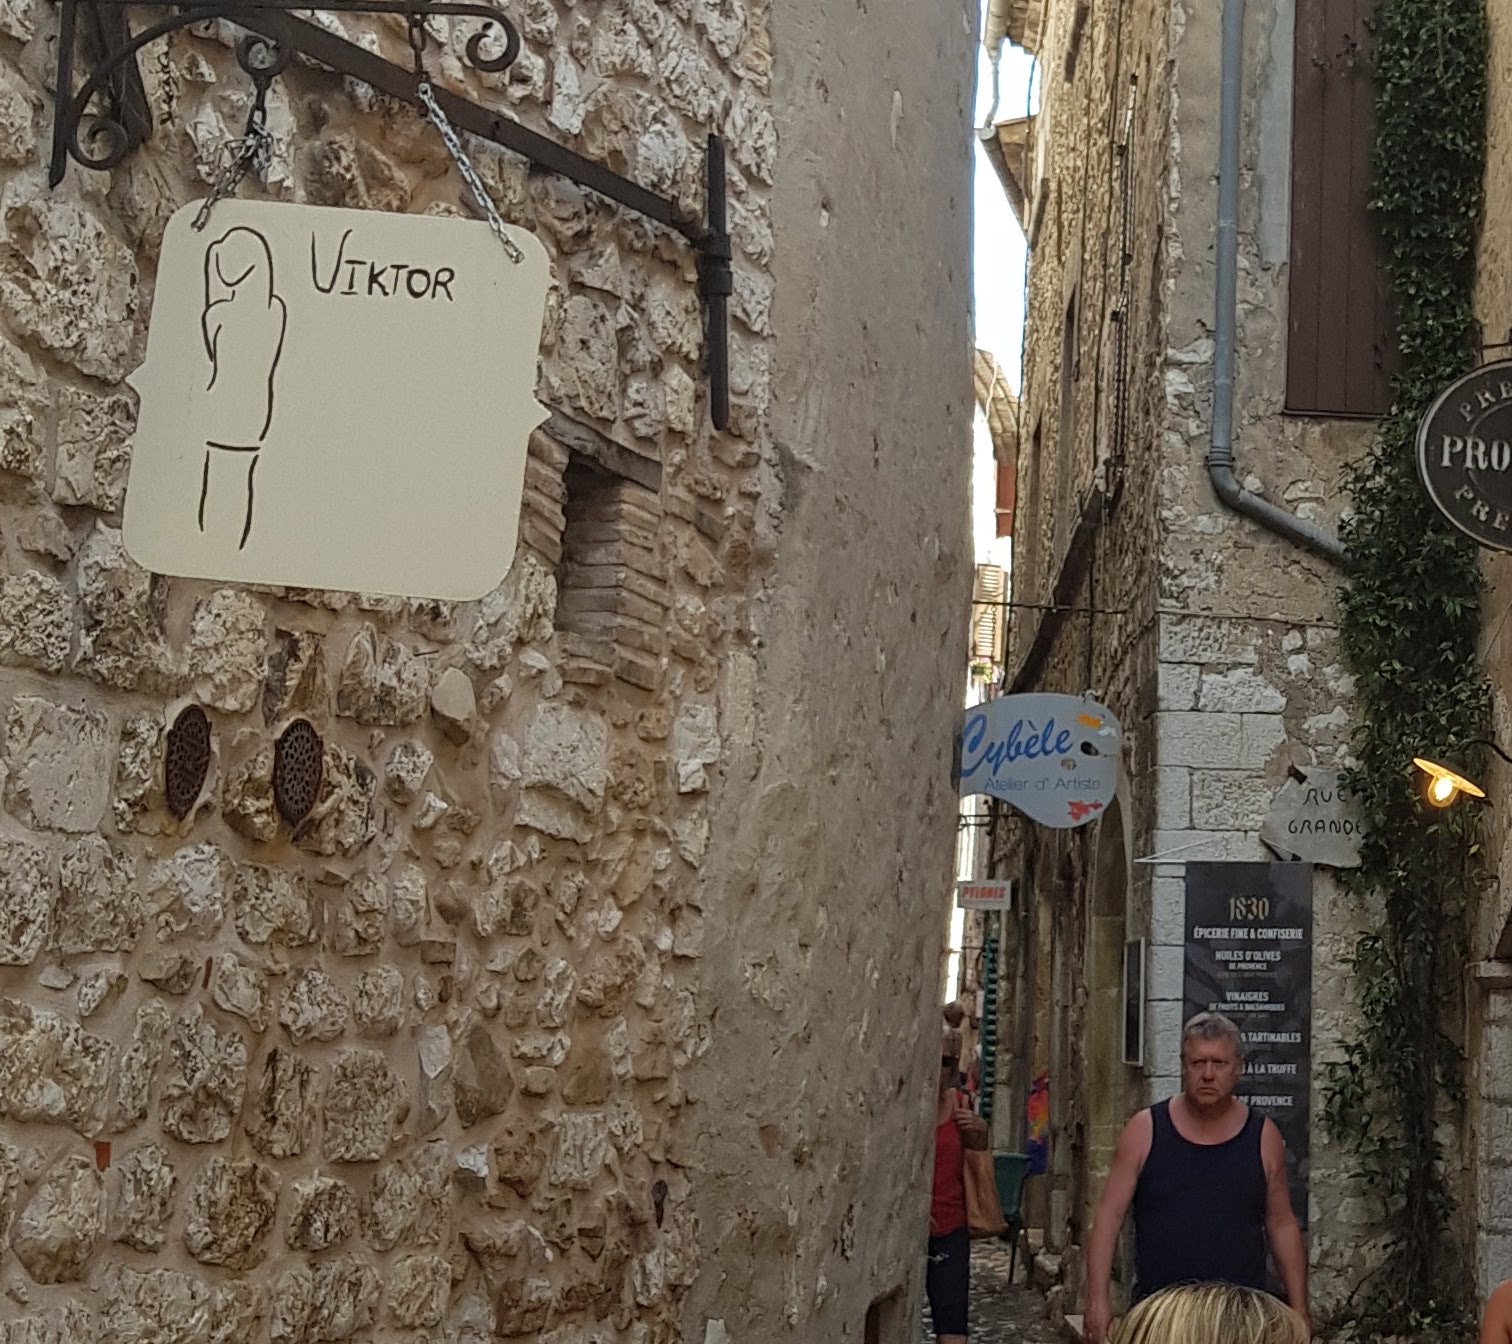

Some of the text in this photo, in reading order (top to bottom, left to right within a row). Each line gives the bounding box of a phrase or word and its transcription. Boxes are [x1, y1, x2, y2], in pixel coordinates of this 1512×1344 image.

[311, 228, 455, 302] VIKTOR
[960, 713, 1073, 778] Cybèle
[985, 777, 1029, 791] Atelier
[1302, 788, 1347, 806] RUE
[1229, 896, 1270, 921] 1830
[1193, 925, 1229, 939] ÉPICERIE
[1230, 927, 1249, 939] FINE
[1257, 928, 1304, 940] CONFISERIE
[1215, 950, 1244, 961] HUILES
[1226, 991, 1269, 1002] VINAIGRES
[1248, 1032, 1301, 1043] TARTINABLES
[1255, 1064, 1266, 1074] LA
[1267, 1064, 1297, 1075] TRUFFE
[1251, 1096, 1293, 1106] PROVENCE
